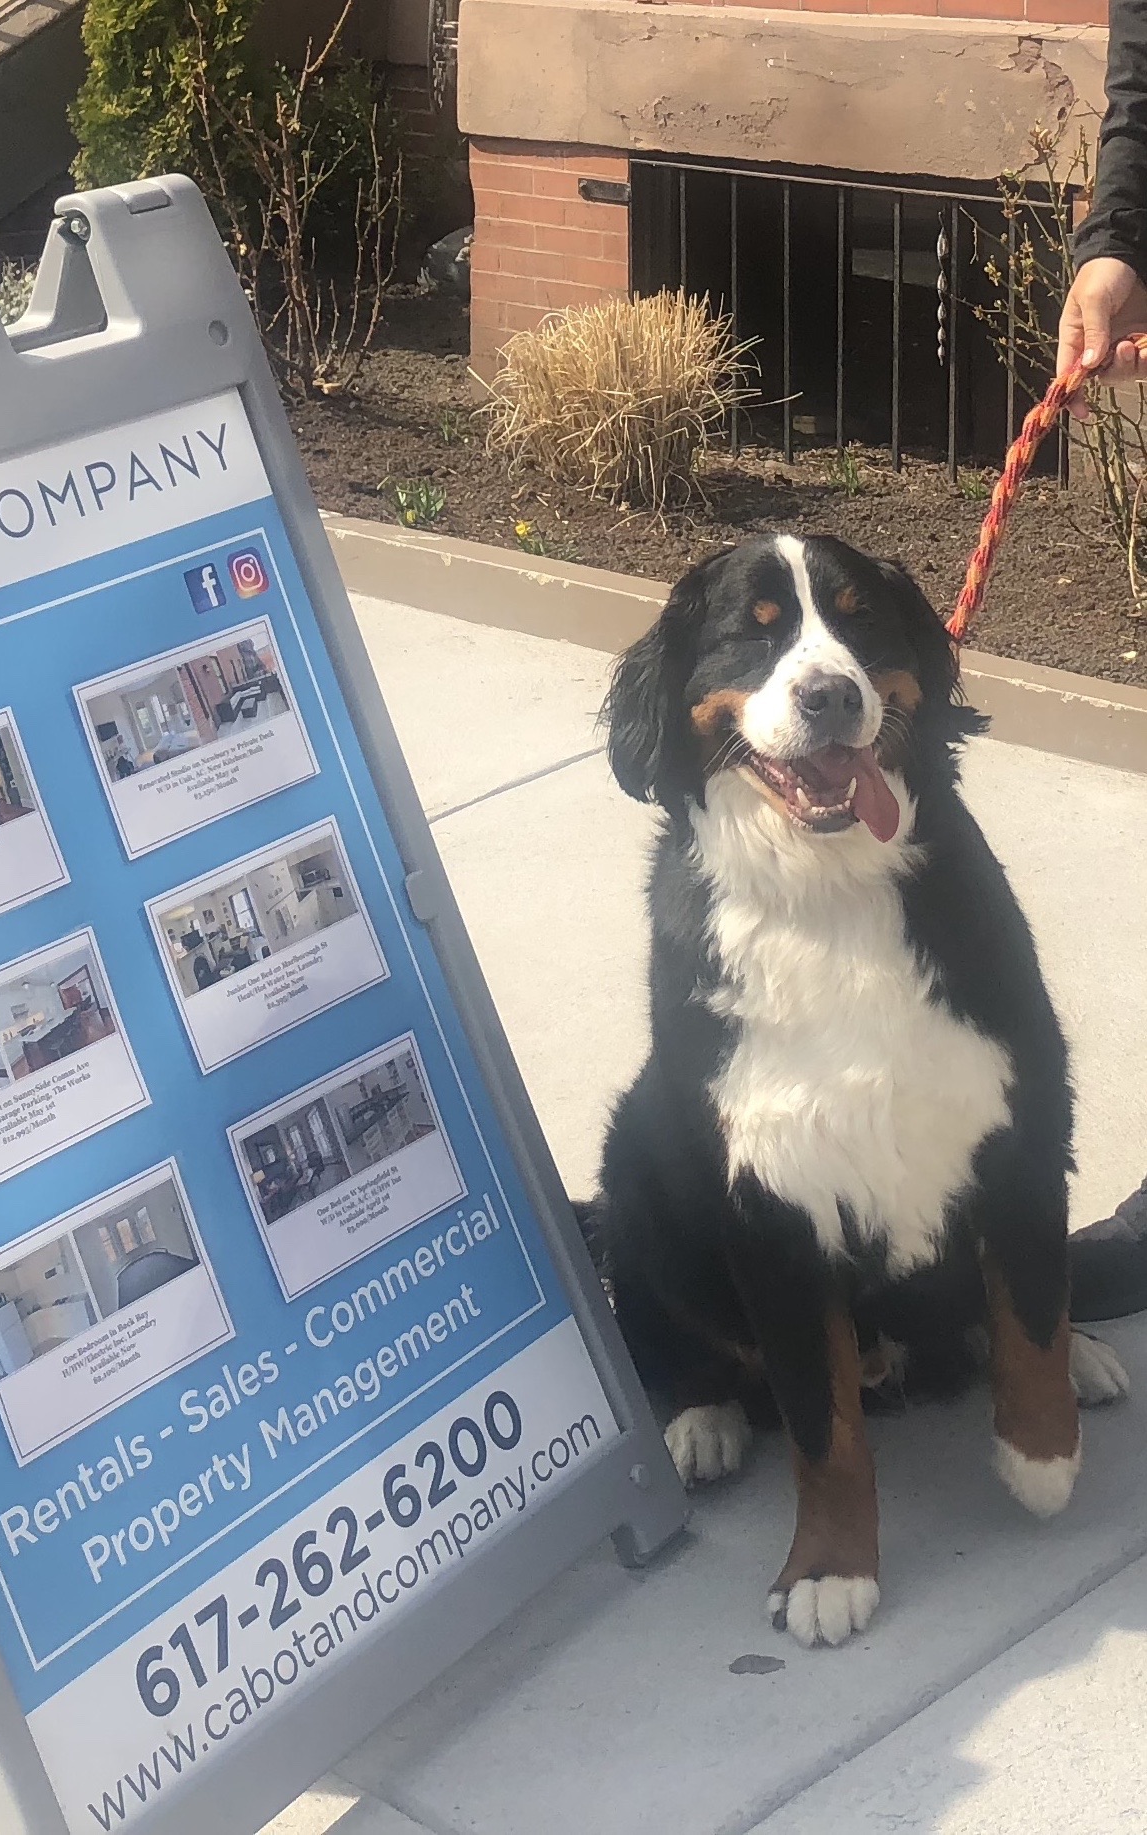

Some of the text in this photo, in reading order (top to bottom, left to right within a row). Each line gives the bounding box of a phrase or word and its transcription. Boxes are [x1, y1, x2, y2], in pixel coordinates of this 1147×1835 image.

[171, 765, 191, 778] Studio
[237, 738, 258, 751] Private
[259, 730, 274, 742] Deck
[207, 763, 221, 774] New
[187, 776, 215, 793] Available
[215, 771, 229, 781] May
[227, 983, 247, 997] Junior
[248, 976, 261, 987] One
[260, 968, 274, 981] Bed
[266, 975, 285, 988] Water
[297, 956, 323, 971] Laundry
[264, 976, 305, 1000] Available Now
[52, 1069, 76, 1083] Comm
[77, 1062, 90, 1073] Ave
[52, 1085, 66, 1096] The
[67, 1073, 91, 1087] Works
[28, 1109, 43, 1120] May
[317, 1206, 330, 1217] One
[330, 1197, 343, 1210] Bed
[340, 1208, 365, 1227] Available
[180, 1352, 279, 1433] Sales
[304, 1192, 500, 1349] Commercial
[63, 1353, 77, 1365] One
[77, 1334, 109, 1356] Bedroom
[117, 1318, 135, 1332] Back
[135, 1311, 149, 1323] Bay
[127, 1319, 156, 1339] Laundry
[90, 1343, 136, 1374] Available Now
[80, 1283, 482, 1583] Property Management
[135, 1390, 523, 1717] 617-262-6200
[86, 1412, 601, 1831] www.cabotandcompany.com
